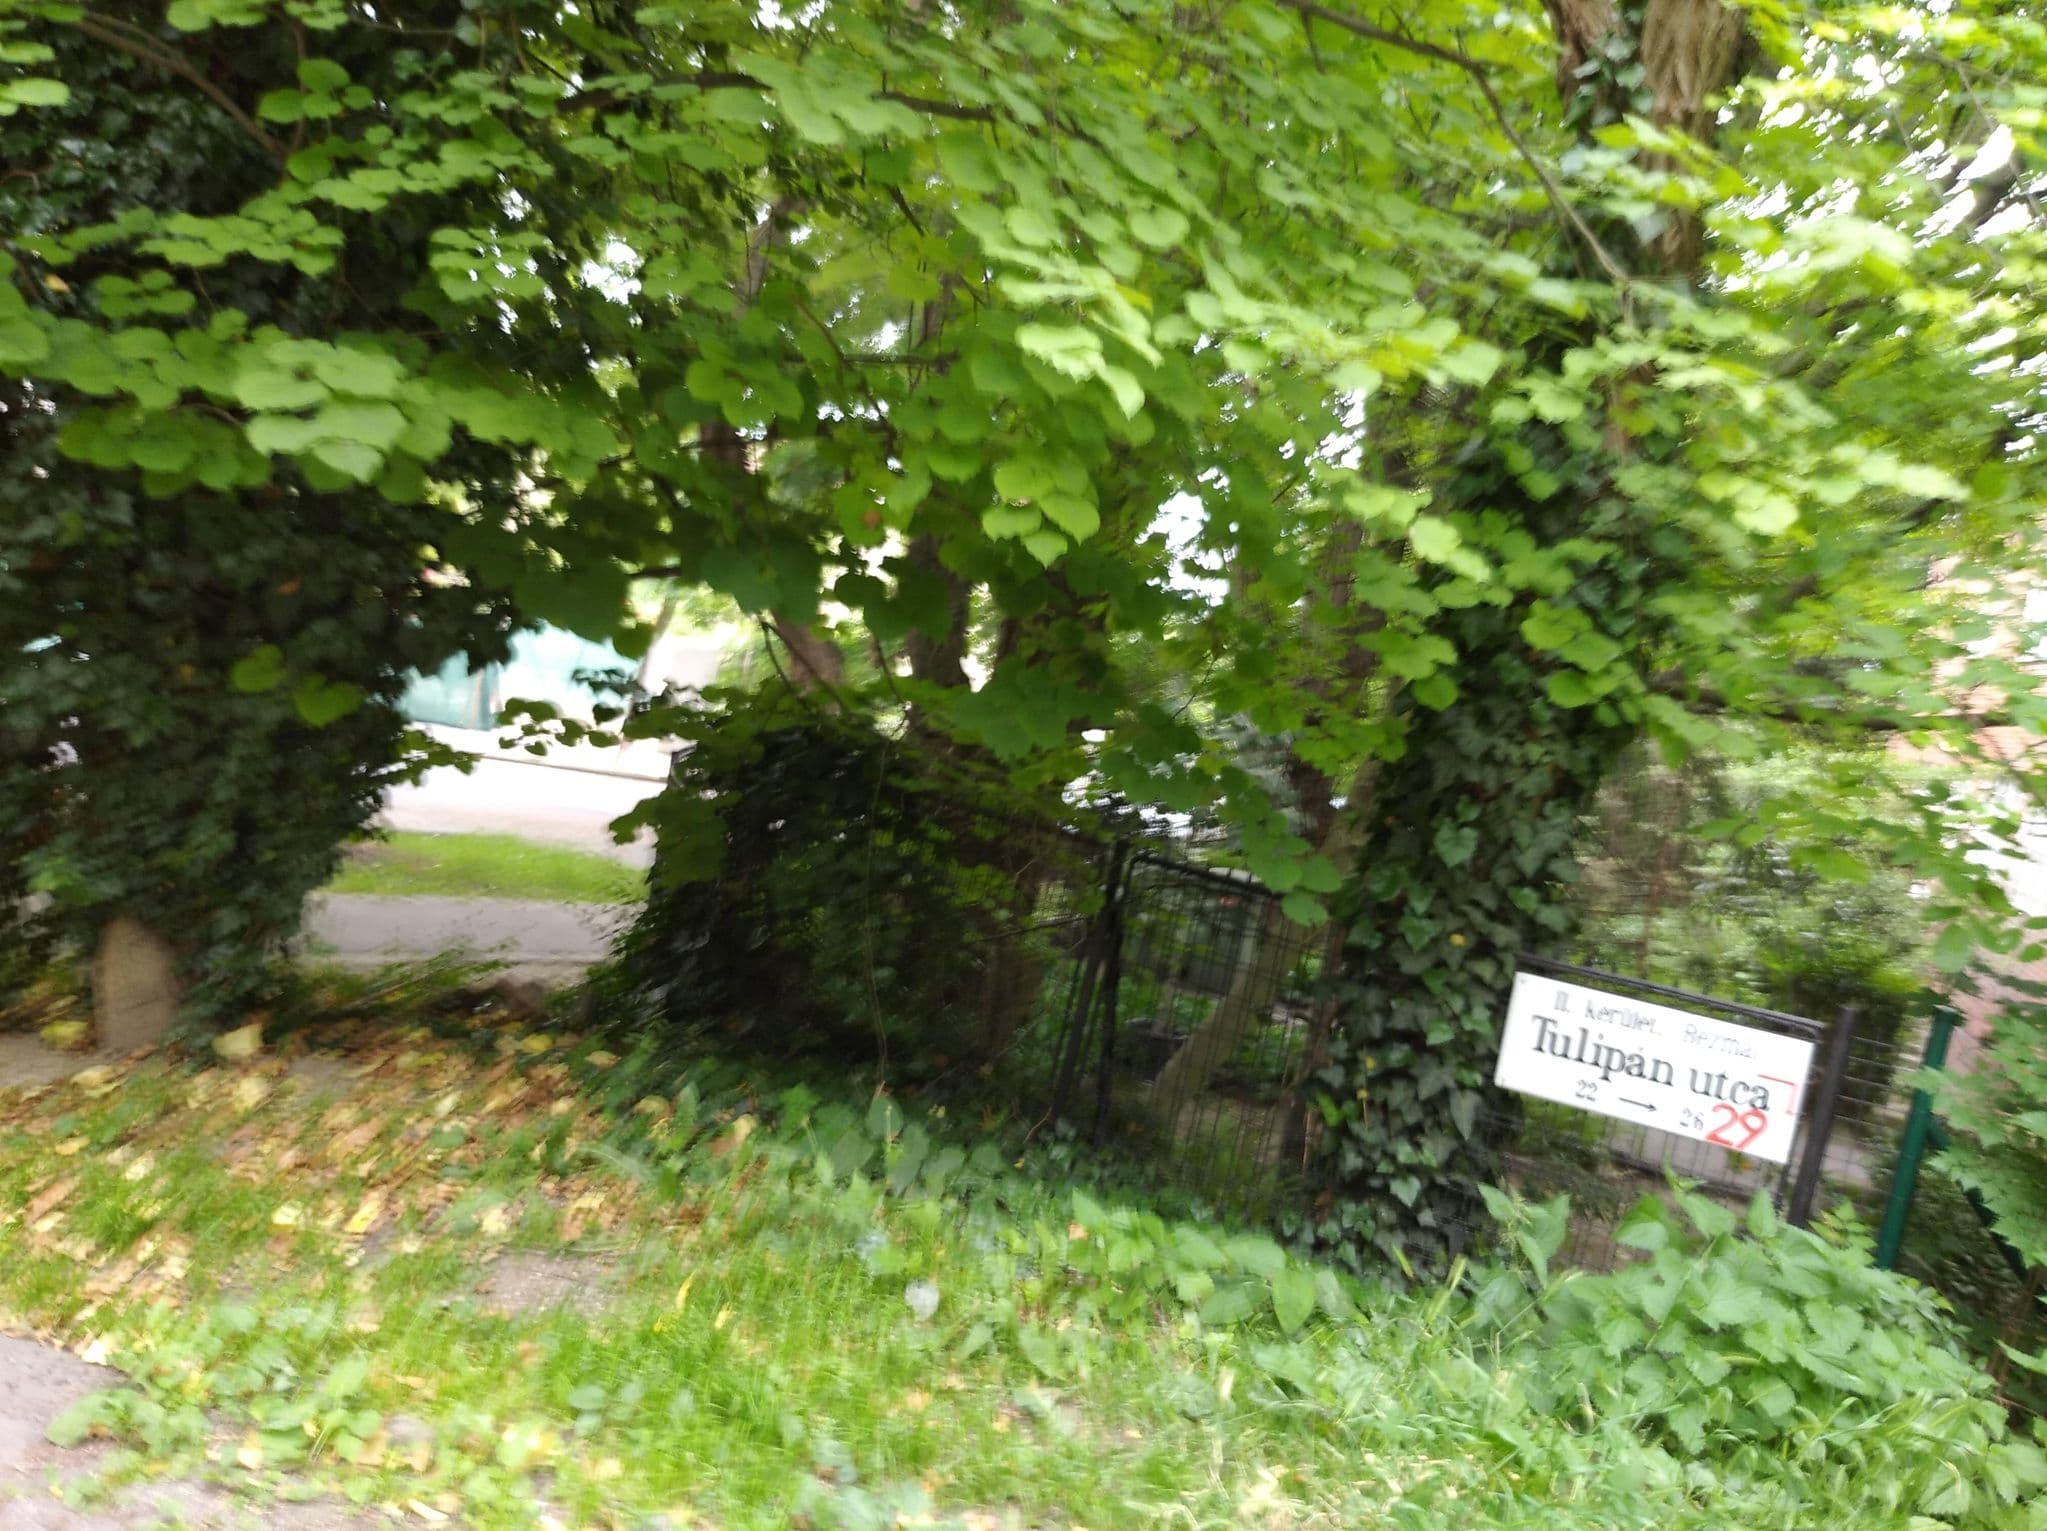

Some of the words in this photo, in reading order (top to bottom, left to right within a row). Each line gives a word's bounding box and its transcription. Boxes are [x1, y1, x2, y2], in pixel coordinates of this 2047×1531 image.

[1531, 1014, 1674, 1087] Tulipán
[1689, 1067, 1770, 1112] utca
[1575, 1080, 1598, 1102] 22
[1705, 1104, 1767, 1150] 29
